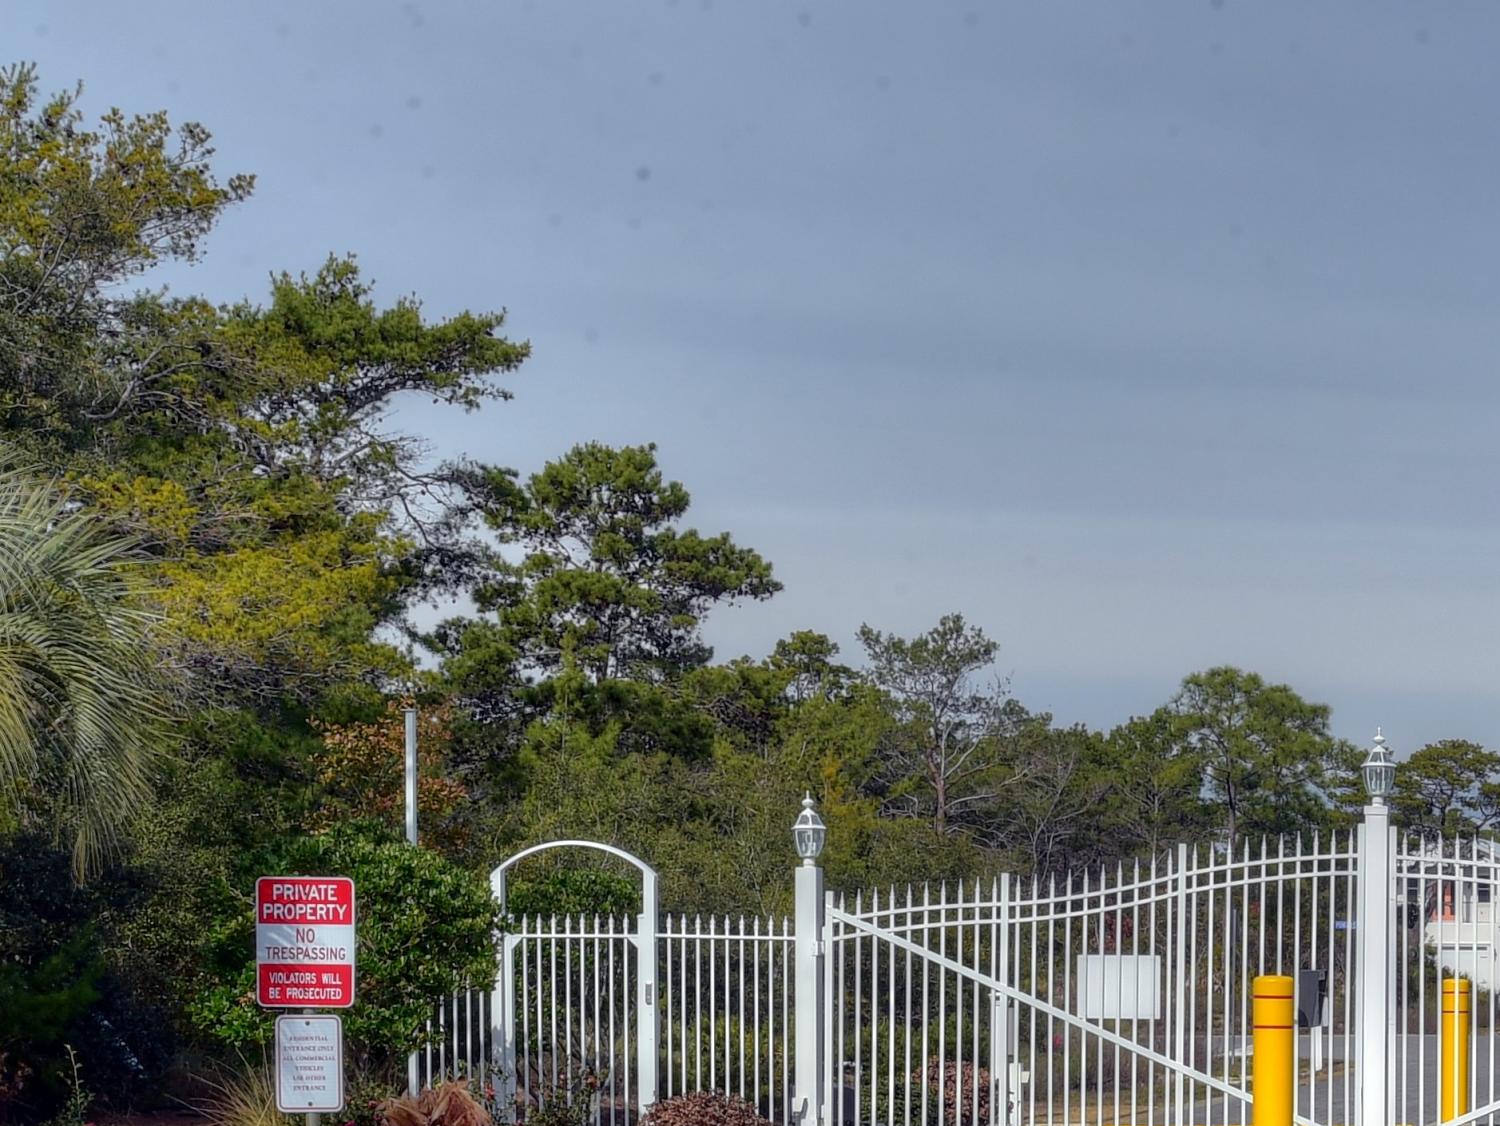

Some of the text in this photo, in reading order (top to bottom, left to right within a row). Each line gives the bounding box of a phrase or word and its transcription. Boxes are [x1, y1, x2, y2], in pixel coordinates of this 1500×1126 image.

[272, 884, 338, 901] PRIVATE
[262, 903, 348, 920] PROPERTY
[295, 928, 316, 943] NO
[265, 947, 346, 960] TRESPASSING
[269, 972, 342, 984] VIOLATORS WILL
[269, 987, 342, 999] BE PROSECUTED
